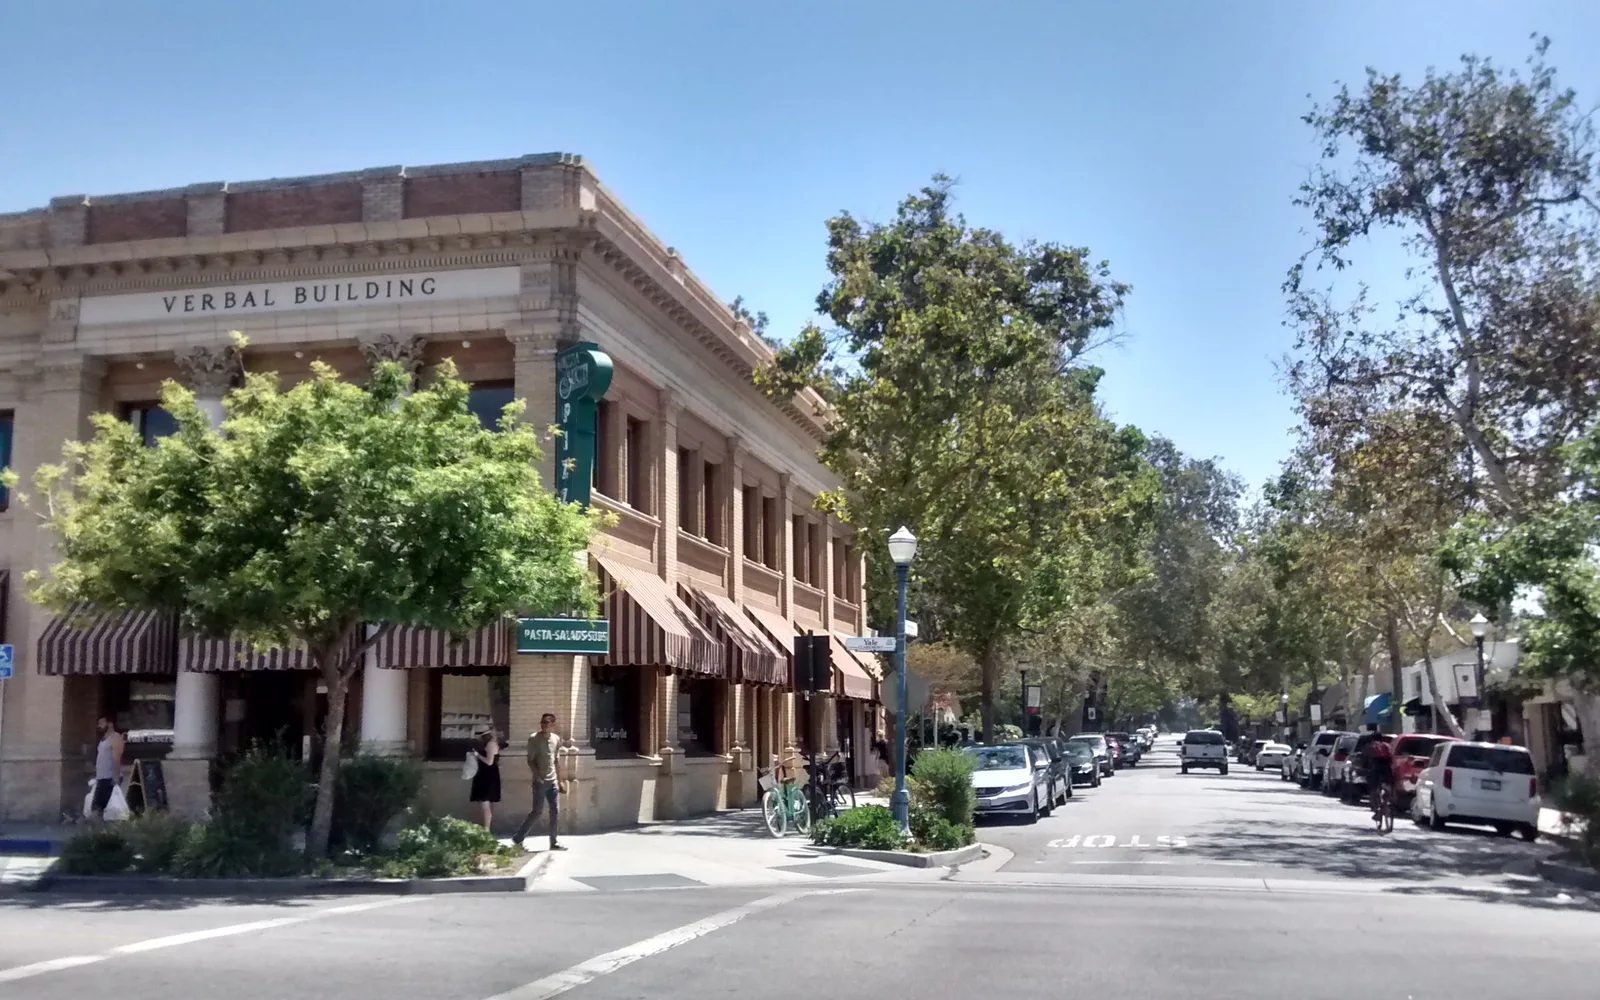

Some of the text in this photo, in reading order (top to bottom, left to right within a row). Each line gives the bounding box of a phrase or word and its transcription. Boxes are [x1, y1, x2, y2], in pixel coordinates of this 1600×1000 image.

[163, 277, 438, 312] VERBAL BUILDING
[1046, 834, 1188, 848] STOP
